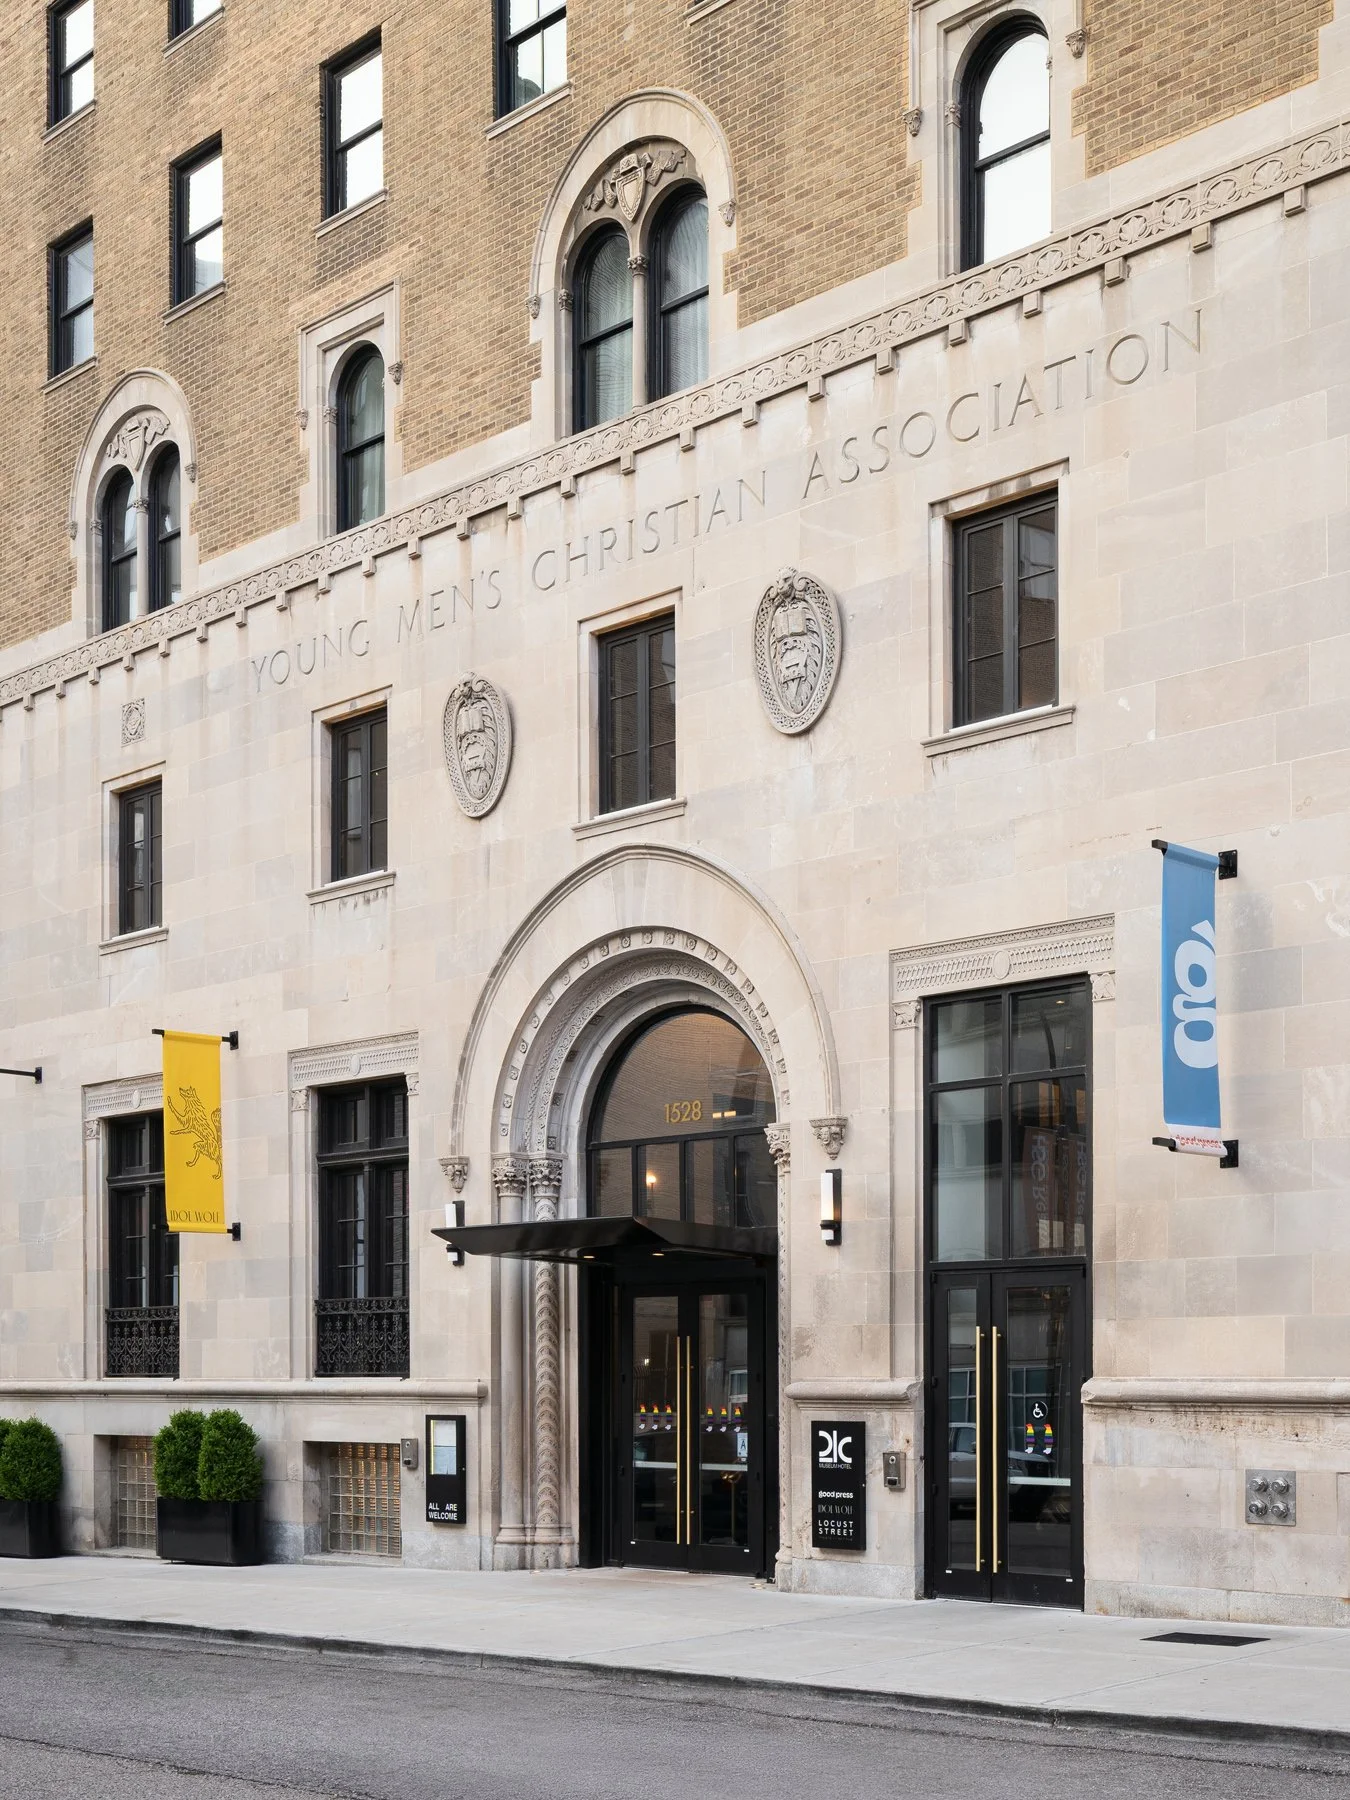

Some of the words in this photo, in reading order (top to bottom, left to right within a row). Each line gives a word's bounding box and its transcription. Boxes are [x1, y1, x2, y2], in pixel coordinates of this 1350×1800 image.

[251, 619, 370, 693] YOUNG
[397, 569, 502, 644] MEN'S
[531, 469, 767, 592] CHRISTIAN
[802, 308, 1203, 500] ASSOCIATION
[663, 1100, 702, 1124] 1528
[170, 1210, 191, 1222] IDOL
[194, 1210, 219, 1223] WOLF
[818, 1490, 835, 1499] good
[835, 1491, 854, 1499] press
[428, 1502, 440, 1510] ALL
[428, 1511, 458, 1520] WELCOME
[818, 1519, 854, 1528] LOCUST
[818, 1527, 854, 1536] STREET
